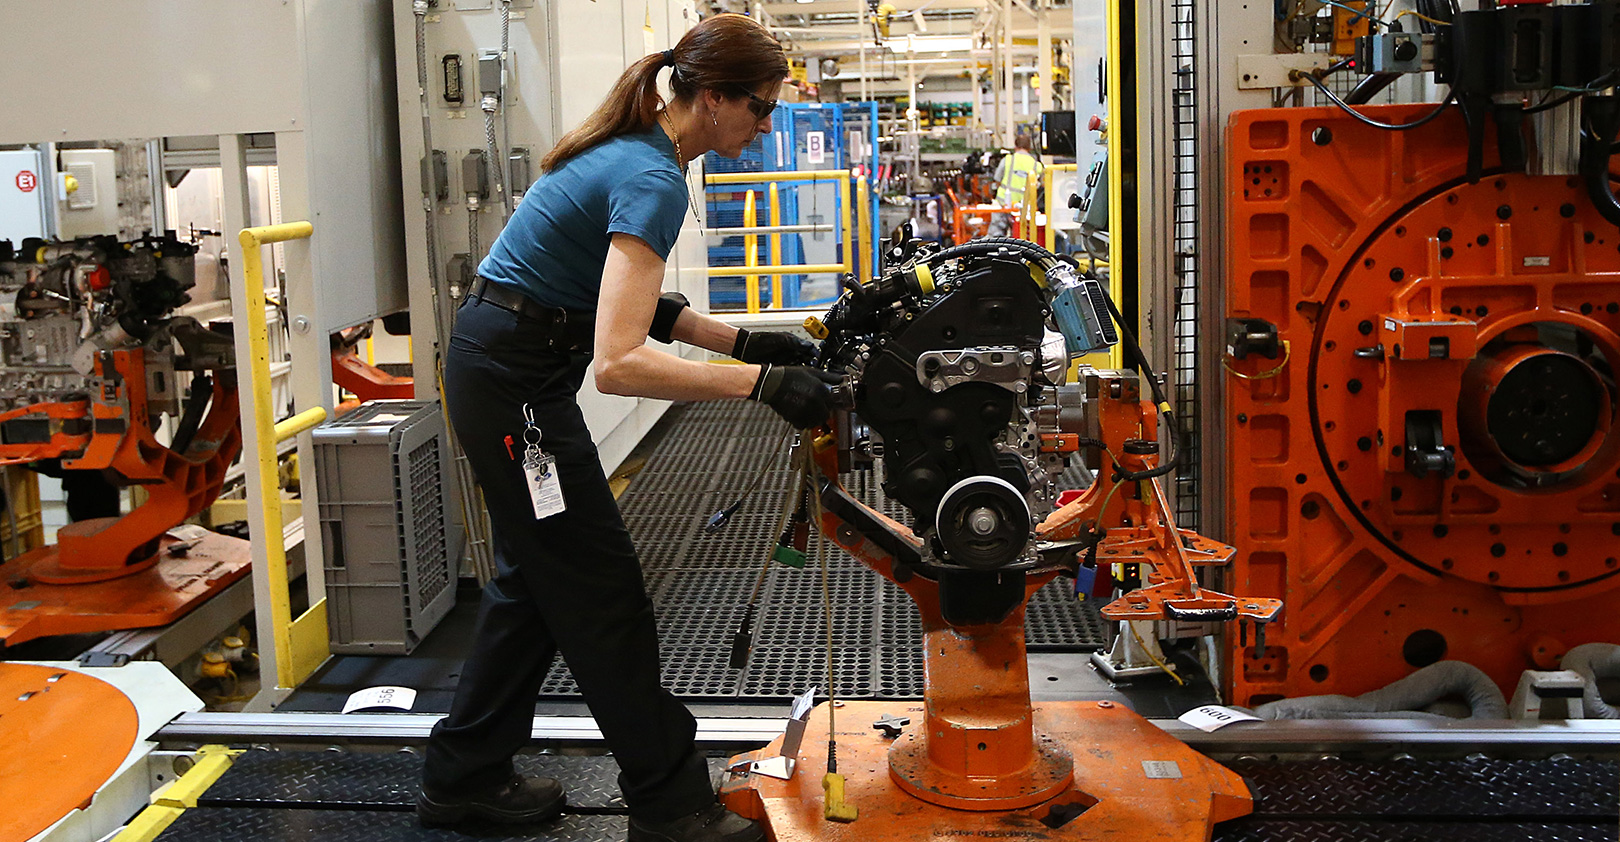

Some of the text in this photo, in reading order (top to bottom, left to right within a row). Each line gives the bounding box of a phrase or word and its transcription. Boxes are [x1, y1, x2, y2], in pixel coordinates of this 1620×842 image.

[810, 136, 820, 151] B
[19, 175, 34, 188] E1
[377, 688, 395, 704] 556
[1199, 707, 1232, 721] 600
